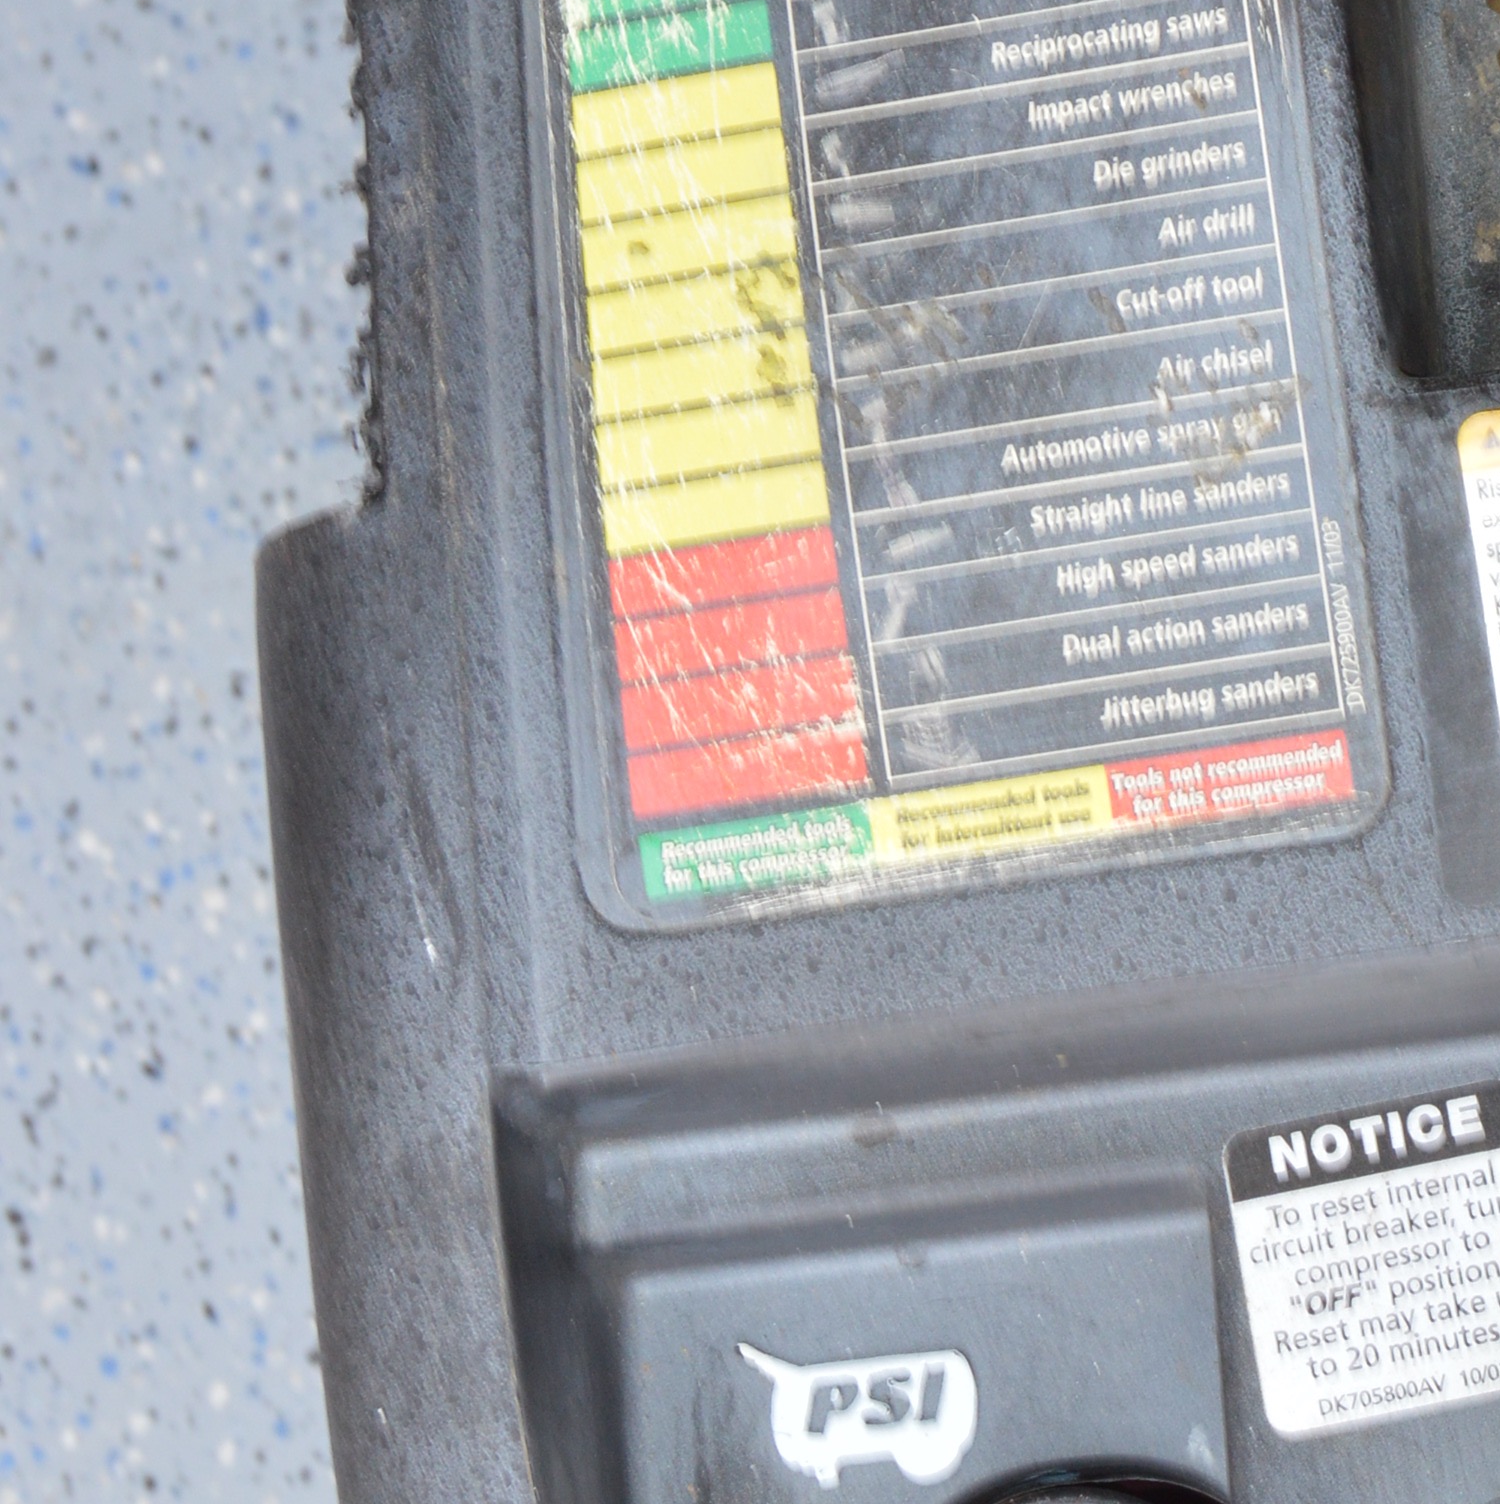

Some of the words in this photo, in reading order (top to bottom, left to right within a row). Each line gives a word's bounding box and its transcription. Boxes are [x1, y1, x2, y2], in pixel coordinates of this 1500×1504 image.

[990, 18, 1161, 71] Reciprocating
[1166, 5, 1229, 40] saws
[1027, 89, 1112, 130] Impact
[1119, 69, 1237, 115] wrenches
[1092, 154, 1136, 188] Die
[1140, 140, 1247, 184] grinders
[1157, 213, 1197, 245] Air
[1202, 202, 1256, 239] drill
[1115, 274, 1206, 317] Cut-off
[1211, 265, 1265, 302] tool
[1157, 351, 1196, 383] Air
[1200, 338, 1274, 379] chisel
[1000, 425, 1152, 474] Automotive
[1029, 490, 1133, 533] Straight
[1139, 484, 1188, 516] line
[1192, 470, 1290, 510] sanders
[1056, 554, 1116, 595] High
[1120, 542, 1198, 587] speed
[1200, 531, 1299, 570] sanders
[1321, 519, 1345, 577] 11/03
[1062, 626, 1122, 664] Dual
[1126, 615, 1207, 654] action
[1210, 601, 1309, 641] sanders
[1100, 686, 1216, 728] Jitterbug
[1220, 670, 1319, 709] sanders
[1110, 766, 1165, 796] Tools
[1169, 760, 1204, 785] not
[1207, 739, 1345, 782] recommended
[1132, 793, 1164, 817] for
[1168, 787, 1206, 813] this
[1211, 771, 1327, 806] compressor
[1267, 1093, 1487, 1184] NOTICE
[1265, 1203, 1301, 1230] To
[1310, 1187, 1378, 1222] reset
[1384, 1159, 1497, 1200] internal
[1248, 1228, 1335, 1266] circuit
[1342, 1208, 1457, 1247] breaker,
[1293, 1237, 1451, 1287] compressor
[1459, 1230, 1492, 1254] to
[1273, 1320, 1351, 1355] Reset
[1358, 1308, 1416, 1338] may
[1422, 1292, 1487, 1324] take
[1289, 1279, 1377, 1316] "OFF"
[1306, 1355, 1338, 1380] to
[1345, 1343, 1381, 1372] 20
[803, 1360, 948, 1438] PSI
[1317, 1372, 1448, 1417] DK705800AV
